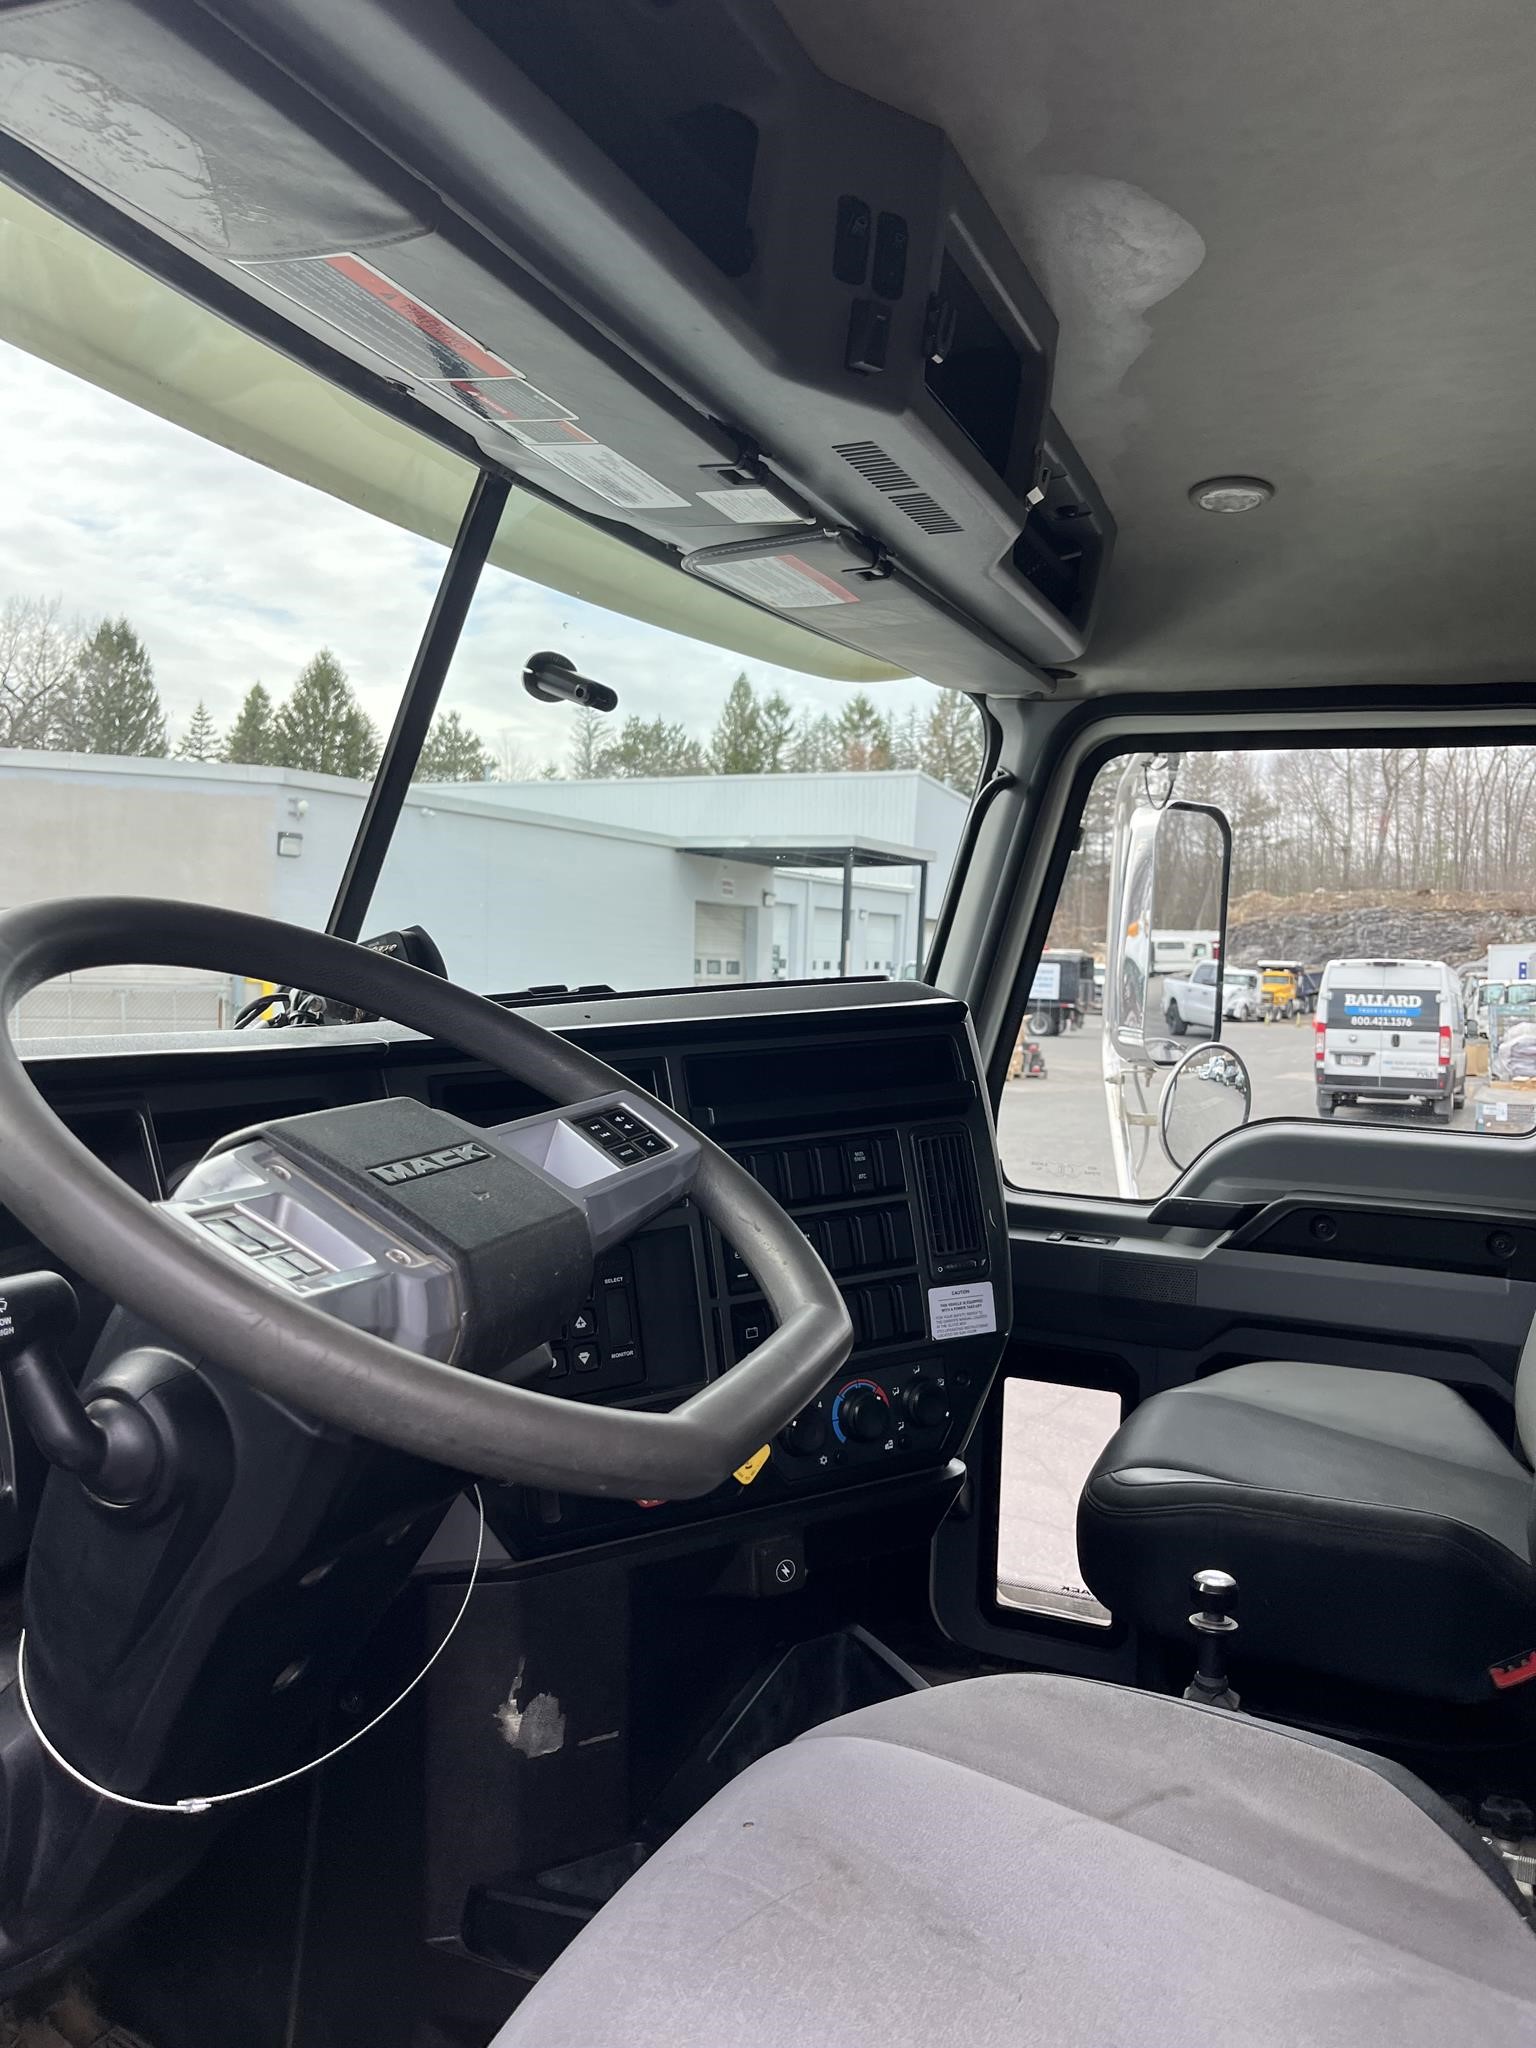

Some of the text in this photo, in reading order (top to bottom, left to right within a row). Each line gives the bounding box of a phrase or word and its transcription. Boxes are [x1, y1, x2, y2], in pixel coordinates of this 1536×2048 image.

[1344, 993, 1422, 1008] BALLARD
[368, 1142, 490, 1183] MACK
[604, 1276, 624, 1284] SELECT
[0, 1316, 12, 1326] OW
[0, 1327, 14, 1336] IGH
[611, 1350, 634, 1359] MONITOR
